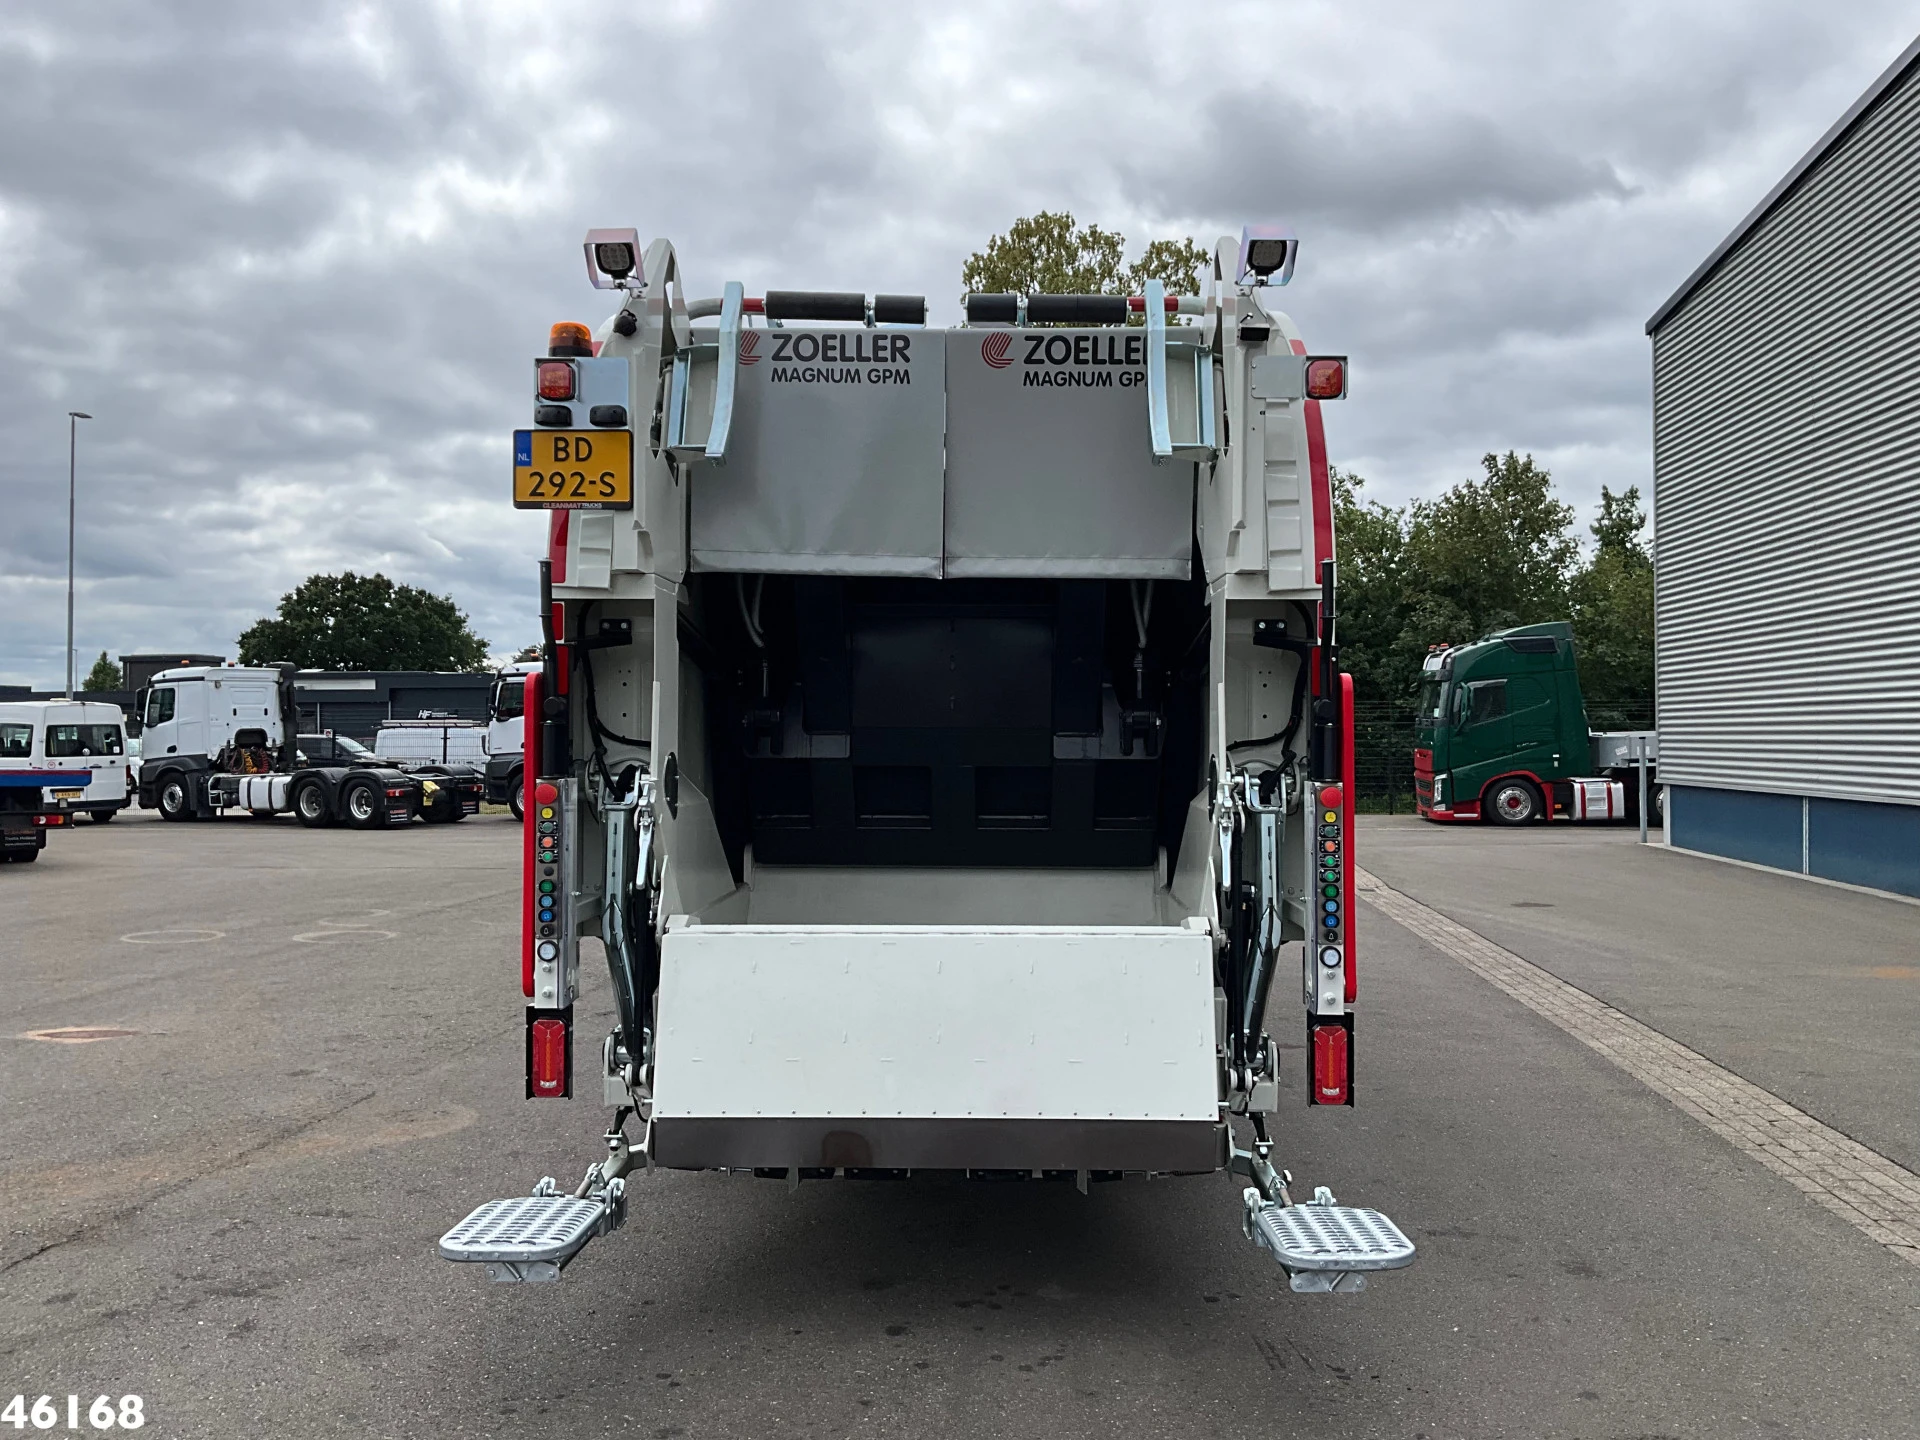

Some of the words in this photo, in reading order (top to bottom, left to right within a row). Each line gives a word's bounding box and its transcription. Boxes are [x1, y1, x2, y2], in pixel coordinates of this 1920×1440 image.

[771, 333, 911, 363] ZOELLER
[770, 367, 862, 384] MAGNUM
[867, 368, 911, 385] GPM
[1022, 371, 1113, 388] MAGNUM
[1118, 371, 1148, 388] GP
[517, 453, 530, 462] NL
[553, 436, 593, 462] BD
[528, 471, 616, 497] 292-S
